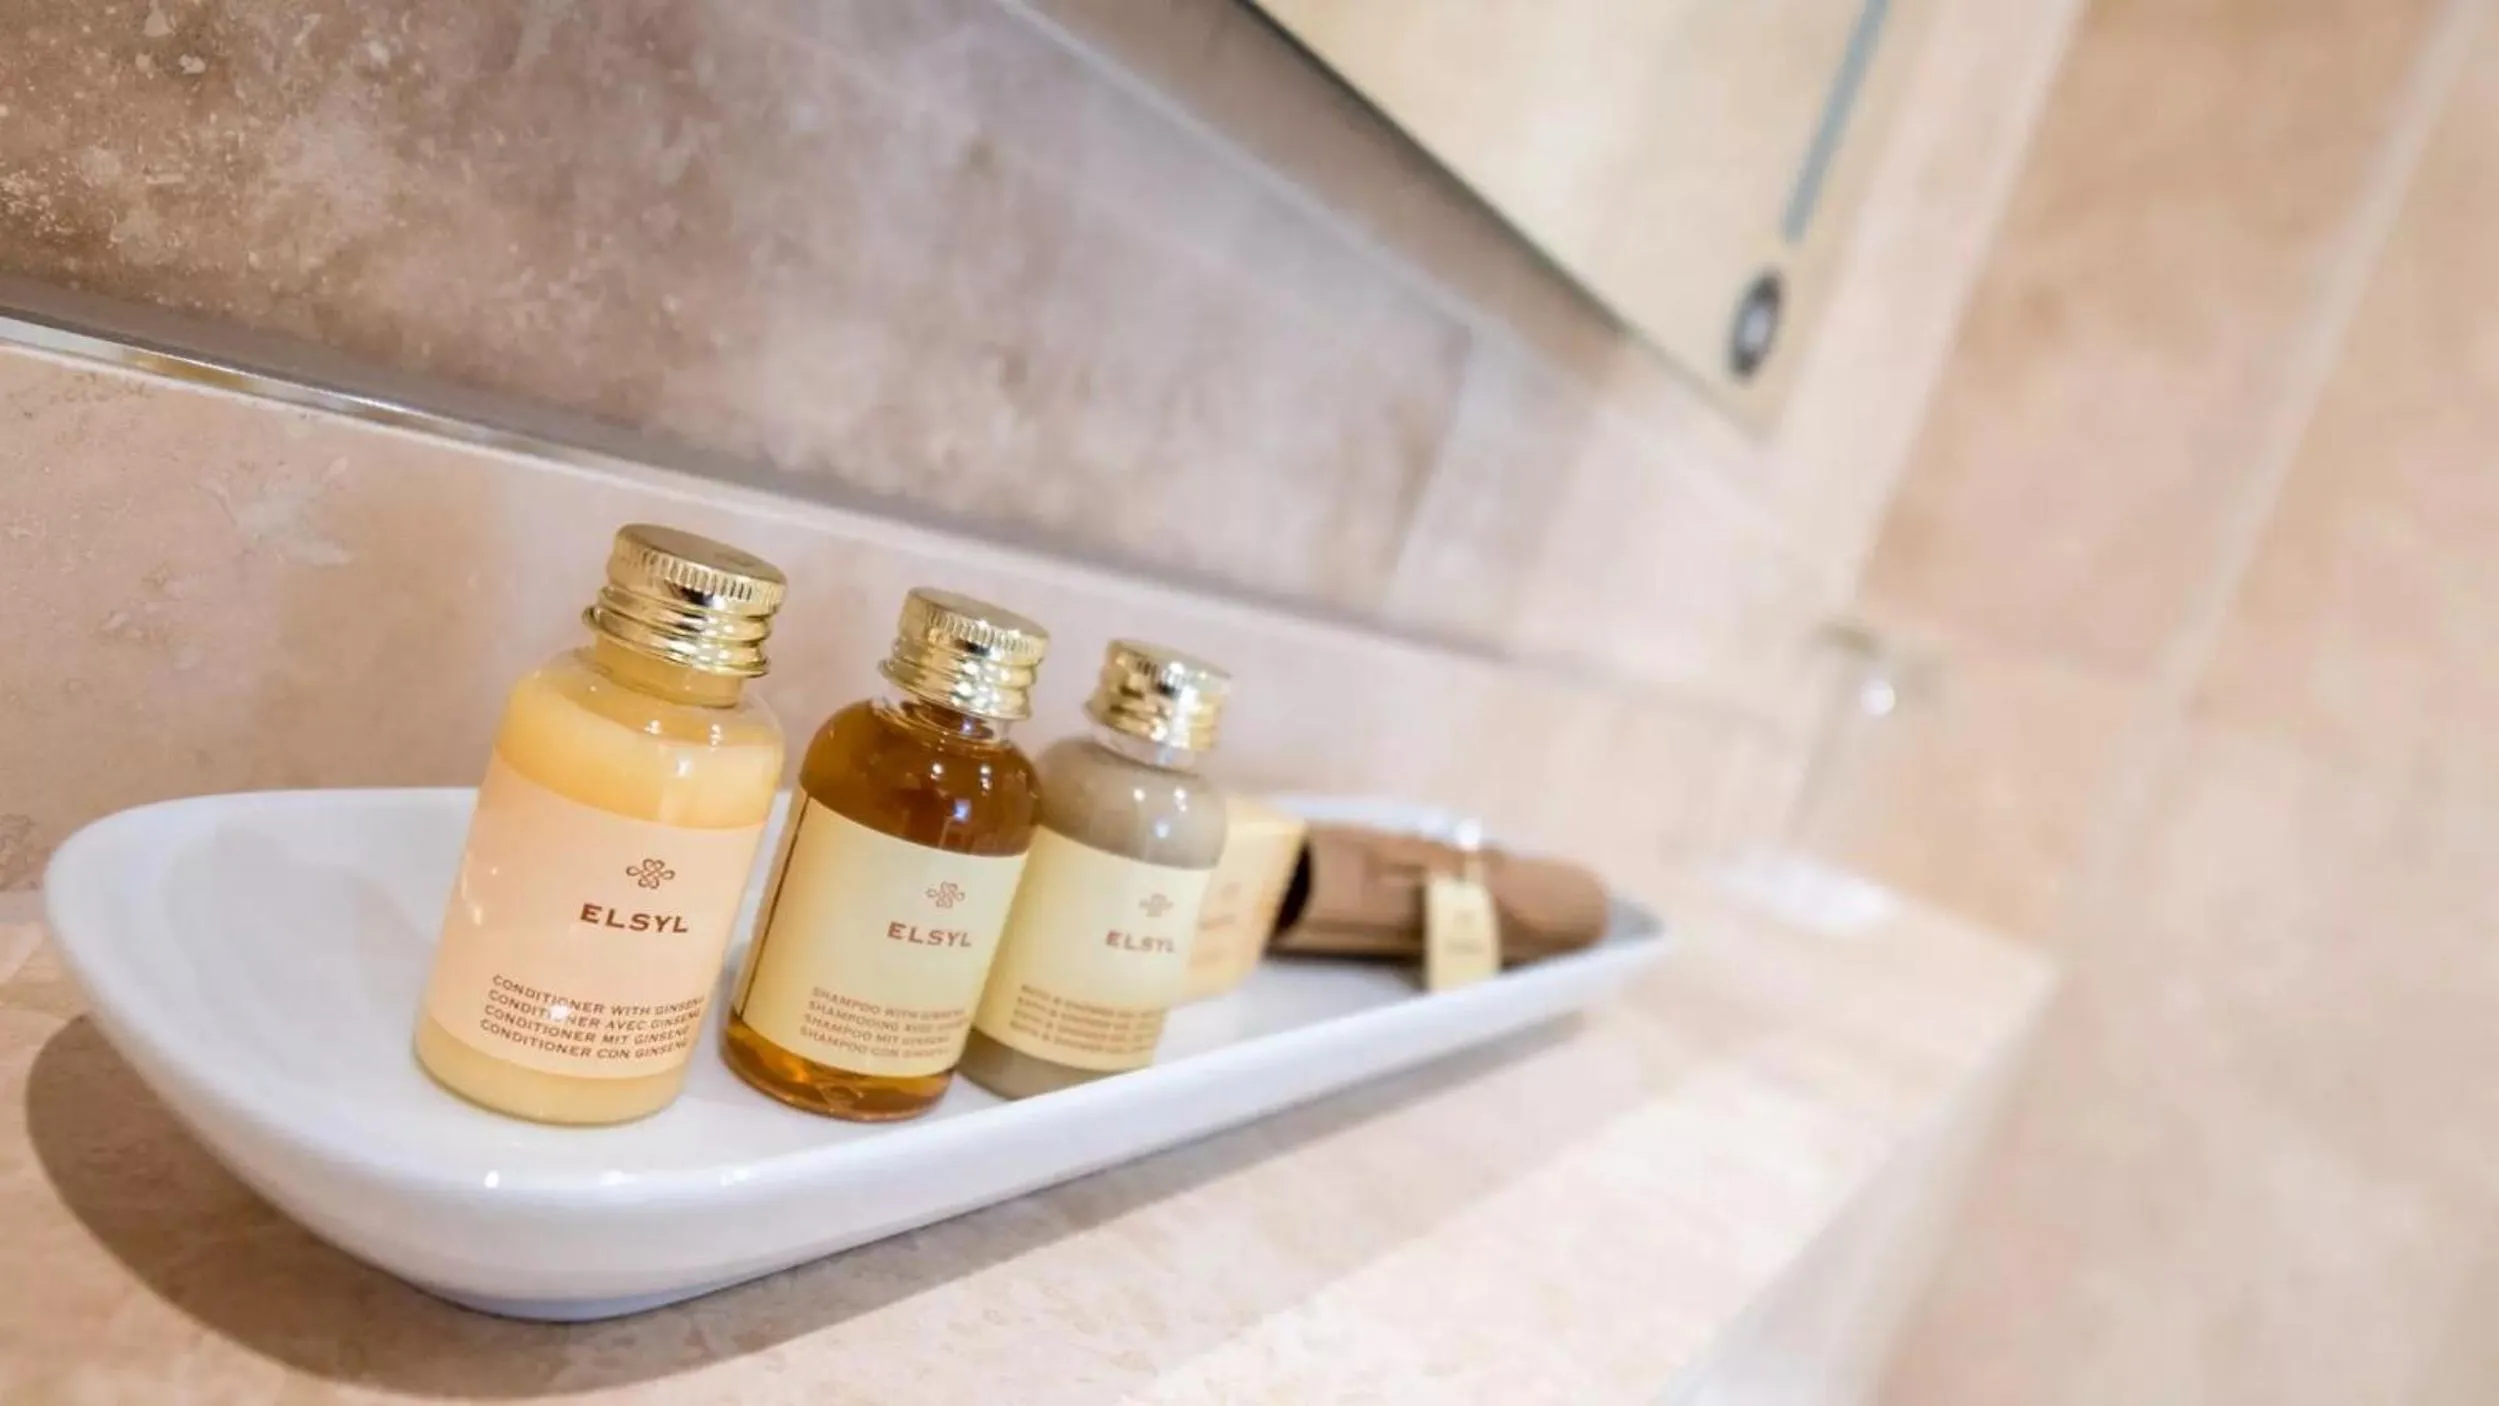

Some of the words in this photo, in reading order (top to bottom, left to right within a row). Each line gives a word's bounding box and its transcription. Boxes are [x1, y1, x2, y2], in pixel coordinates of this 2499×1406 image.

[580, 903, 688, 933] ELSYL
[886, 921, 972, 948] ELSYL
[1105, 929, 1175, 953] ELSYL
[493, 974, 605, 1014] CONDITIONER
[610, 1004, 650, 1016] WITH
[480, 1019, 592, 1058] CONDITIONER
[596, 1047, 630, 1060] CON
[484, 1004, 596, 1044] CONDITIONER
[602, 1033, 629, 1045] MIT
[605, 1018, 647, 1032] AVEC
